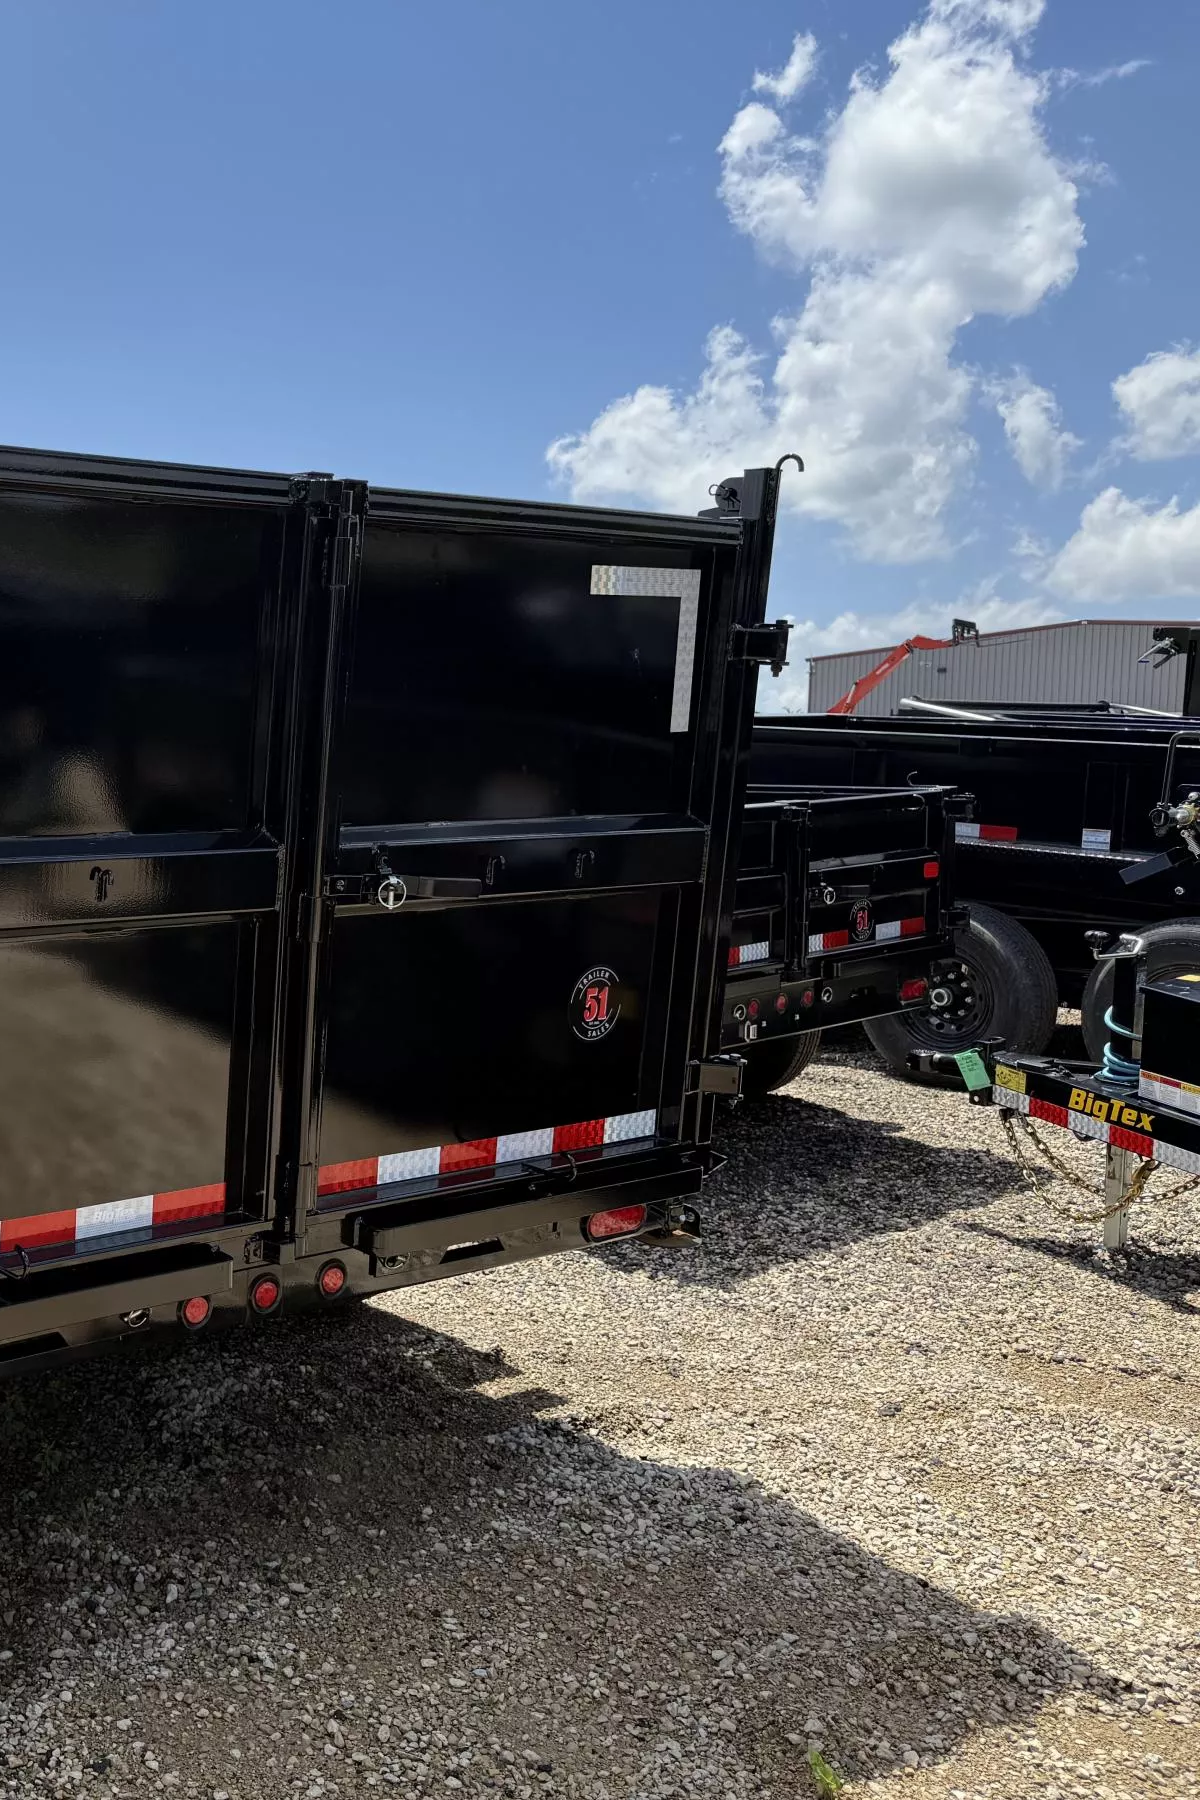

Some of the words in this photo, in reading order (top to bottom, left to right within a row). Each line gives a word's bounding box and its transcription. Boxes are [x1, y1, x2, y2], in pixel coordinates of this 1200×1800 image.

[856, 910, 868, 930] 51
[579, 970, 610, 989] TRAILER
[583, 986, 609, 1022] 51
[587, 1022, 610, 1037] SALES
[1068, 1087, 1155, 1132] BigTex
